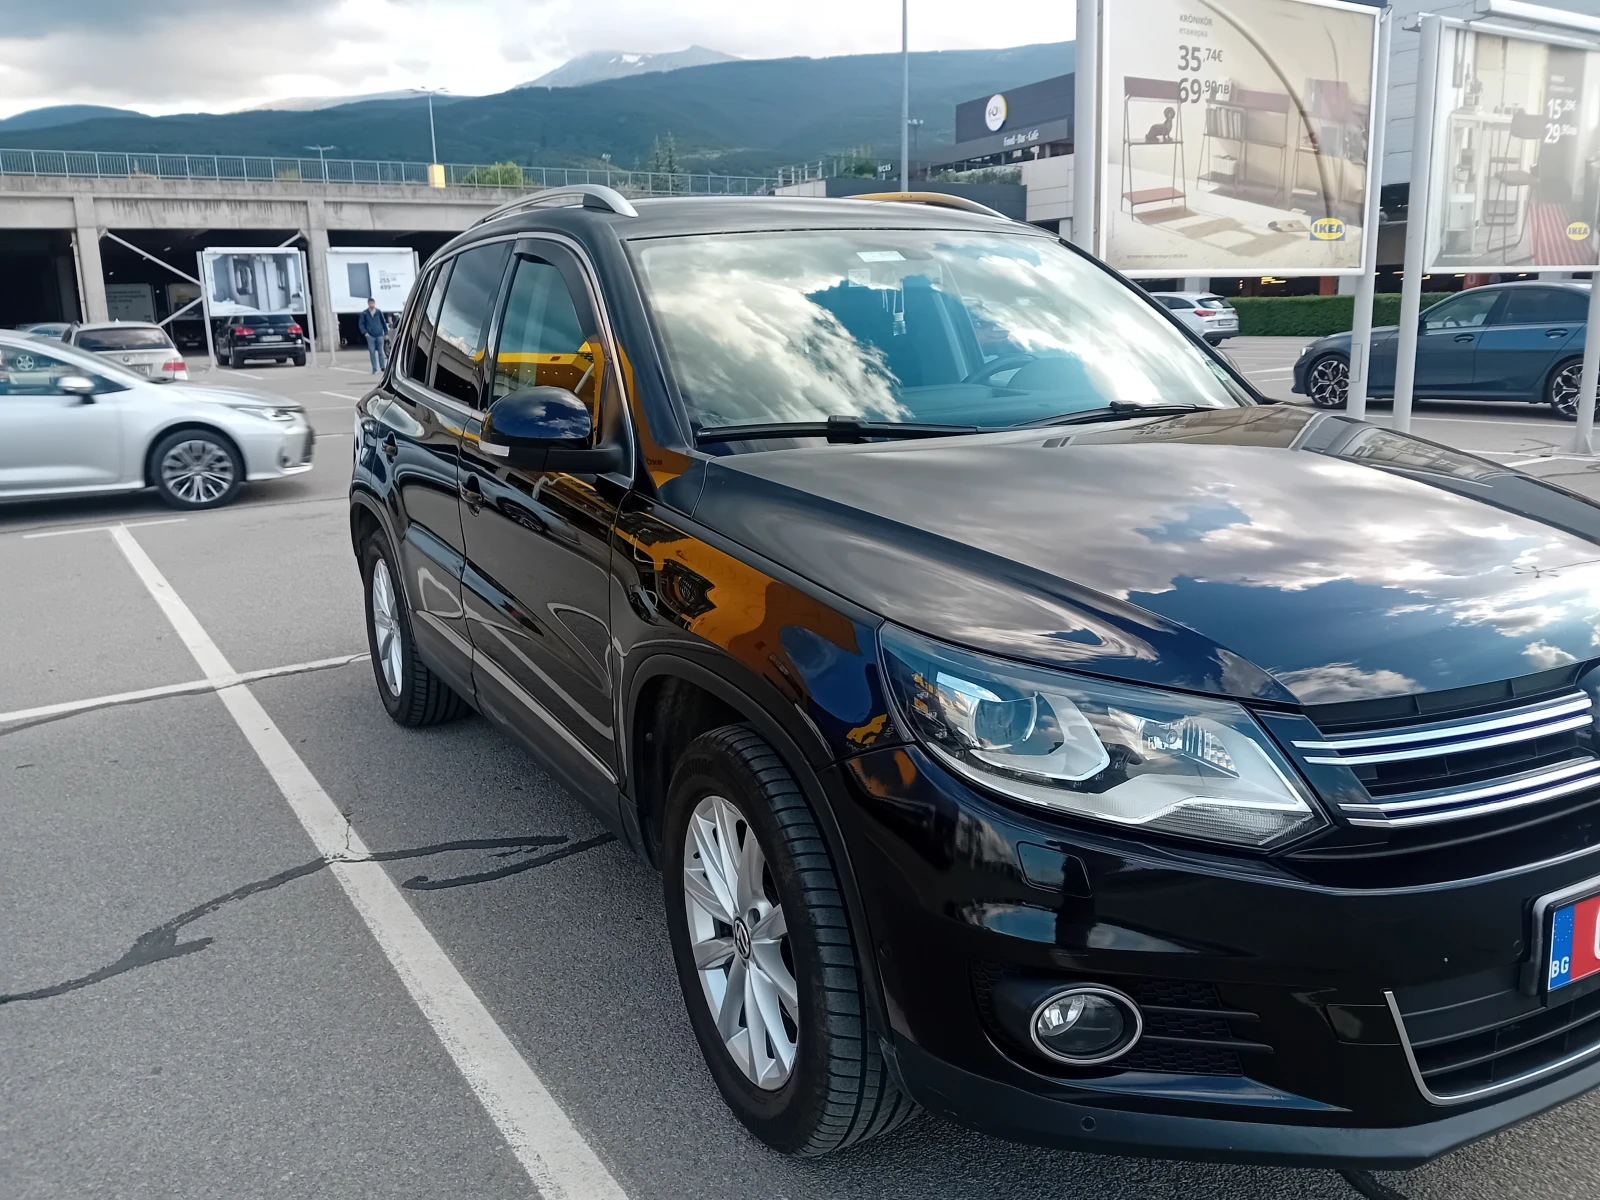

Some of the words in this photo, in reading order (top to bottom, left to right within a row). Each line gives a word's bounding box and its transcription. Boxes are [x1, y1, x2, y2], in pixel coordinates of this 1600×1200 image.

[1313, 223, 1343, 233] IKEA
[1568, 227, 1589, 235] IKEA
[1551, 956, 1570, 979] BG
